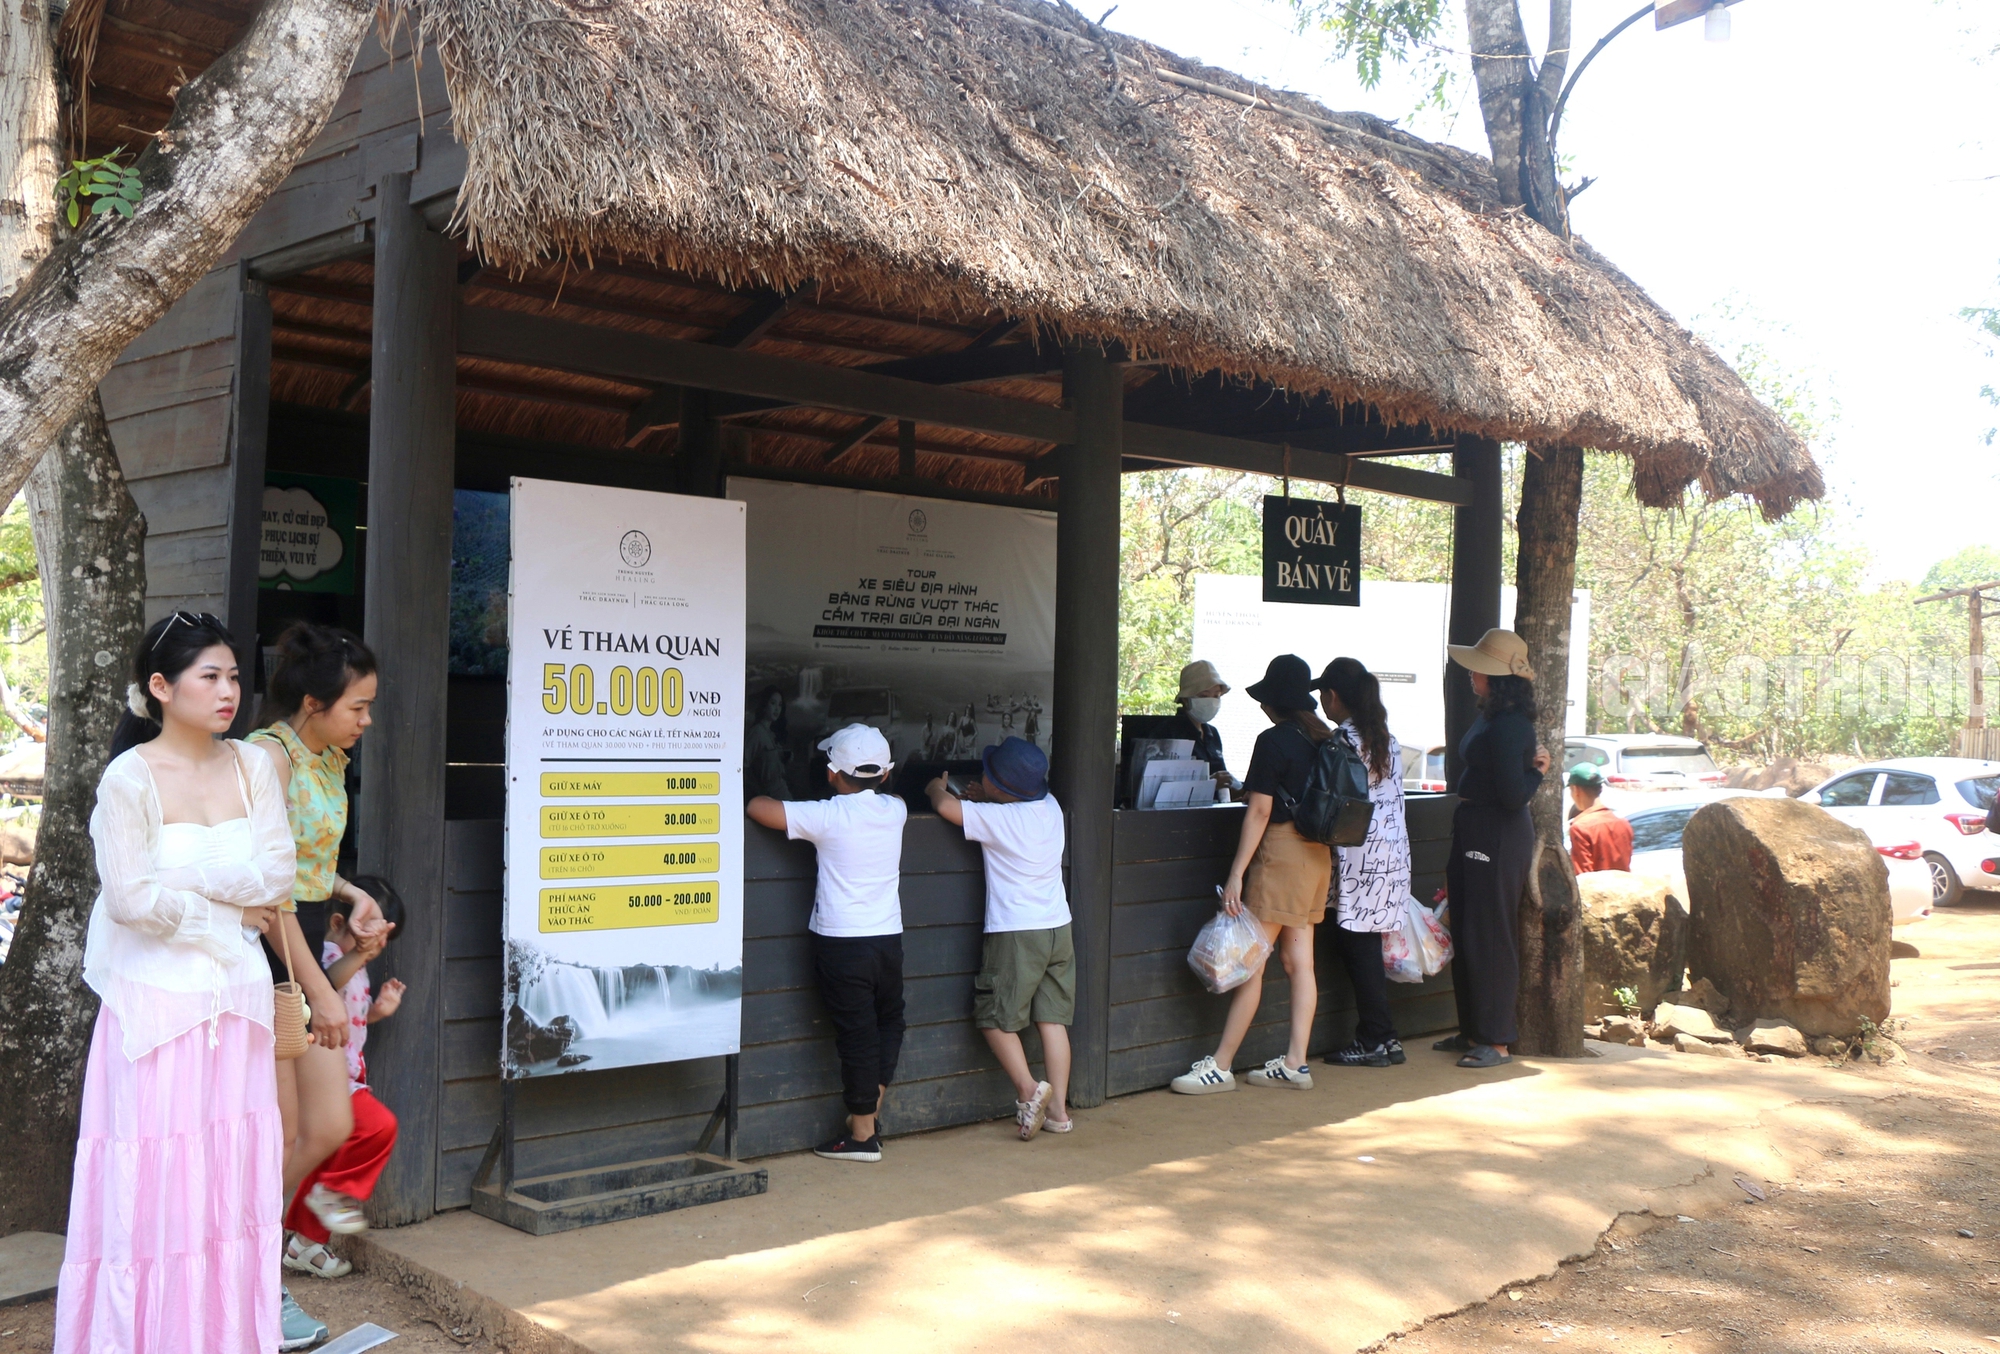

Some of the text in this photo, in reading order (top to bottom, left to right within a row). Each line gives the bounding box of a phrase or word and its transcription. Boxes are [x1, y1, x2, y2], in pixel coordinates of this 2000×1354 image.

[283, 509, 294, 524] CỬ
[295, 510, 309, 526] CHỈ
[310, 515, 326, 529] ĐẸP
[1284, 506, 1339, 548] QUẦY
[265, 530, 320, 549] PHỤC LỊCH SỰ
[290, 552, 304, 564] VUI
[907, 569, 936, 579] TOUR
[1276, 555, 1352, 592] BÁN VÉ
[858, 578, 977, 596] XE SIÊU ĐỊA HÌNH
[828, 591, 870, 605] BĂNG
[875, 593, 915, 608] RỪNG
[965, 600, 999, 613] THÁC
[822, 606, 1000, 628] CẮM TRẠI GIỮA ĐẠI NGÀN
[542, 624, 720, 660] VÉ THAM QUAN
[542, 663, 721, 717] 50.000 VNĐ
[693, 708, 721, 717] NGƯỜI
[542, 728, 554, 736] ÁP
[556, 729, 584, 738] DỤNG
[609, 729, 627, 738] CÁC
[629, 729, 652, 738] NGÀY
[667, 729, 682, 738] TẾT
[683, 729, 701, 738] NĂM
[542, 741, 555, 749] (VÉ
[581, 742, 603, 750] QUAN
[652, 742, 666, 750] PHỤ
[549, 780, 602, 790] GIỮ XE MÁY
[666, 778, 697, 789] 10.000
[549, 810, 605, 821] GIỮ XE Ô TÔ
[664, 813, 697, 825] 30.000
[549, 851, 604, 863] GIỮ XE Ô TÔ
[663, 852, 696, 865] 40.000
[549, 893, 596, 903] PHÍ MANG
[628, 894, 662, 908] 50.000
[674, 892, 711, 905] 200.000
[549, 904, 590, 914] THỨC ĂN
[548, 915, 594, 926] VÀO THÁC
